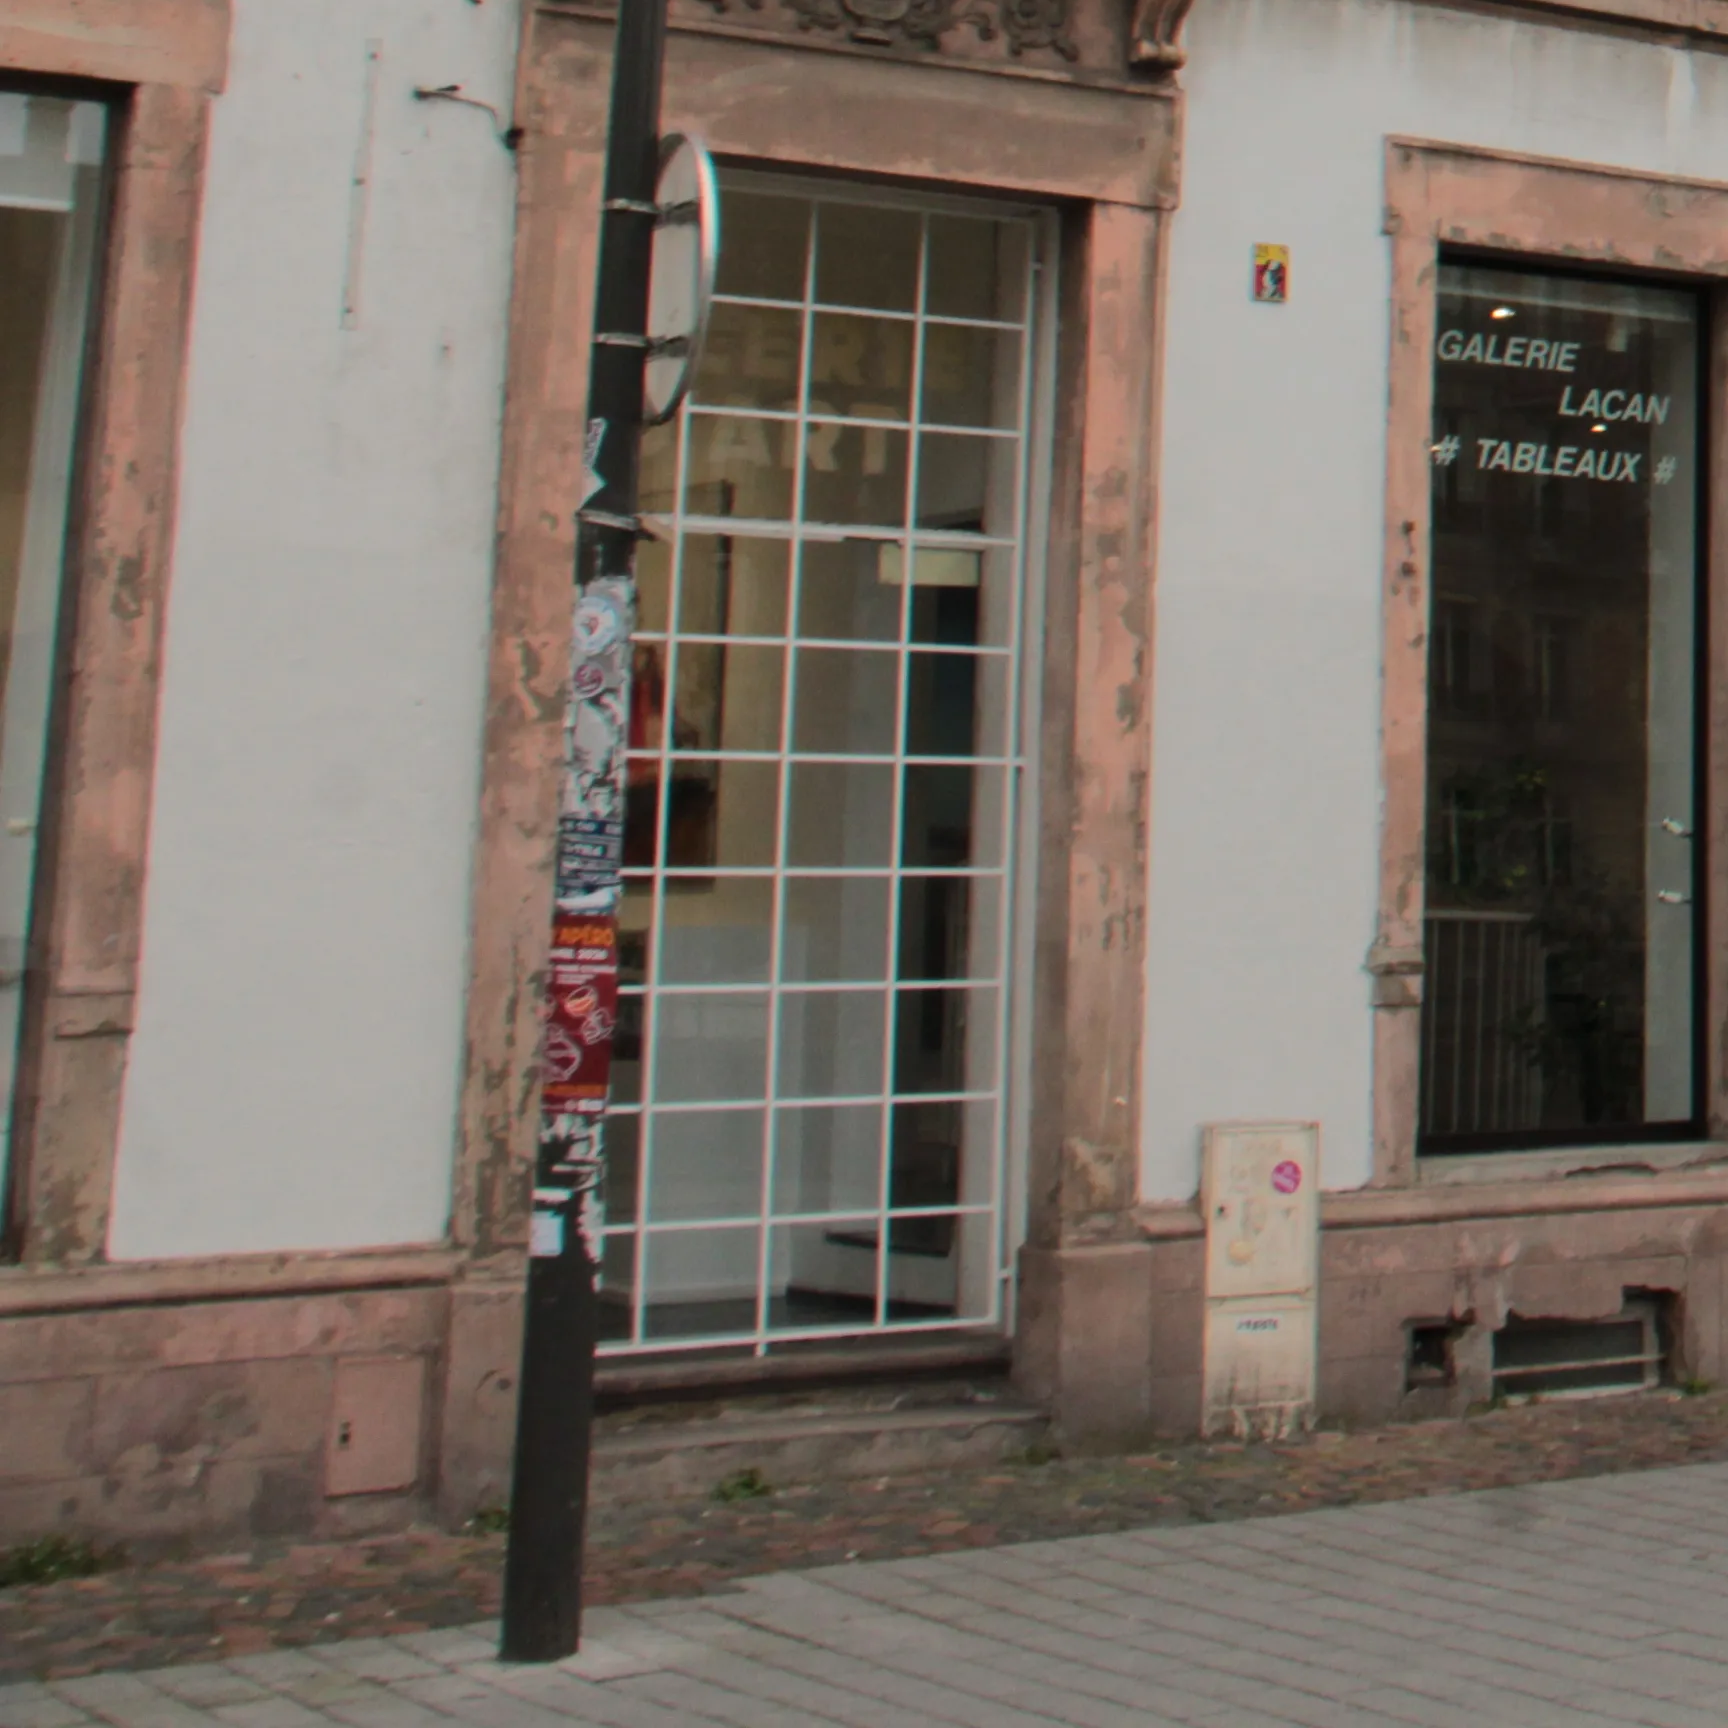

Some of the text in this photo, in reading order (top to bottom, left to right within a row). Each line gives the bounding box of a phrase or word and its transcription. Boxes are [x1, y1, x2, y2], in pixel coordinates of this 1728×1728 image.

[1436, 328, 1582, 373] GALERIE
[1557, 384, 1671, 426] LACAN
[1476, 437, 1642, 483] TABLEAUX
